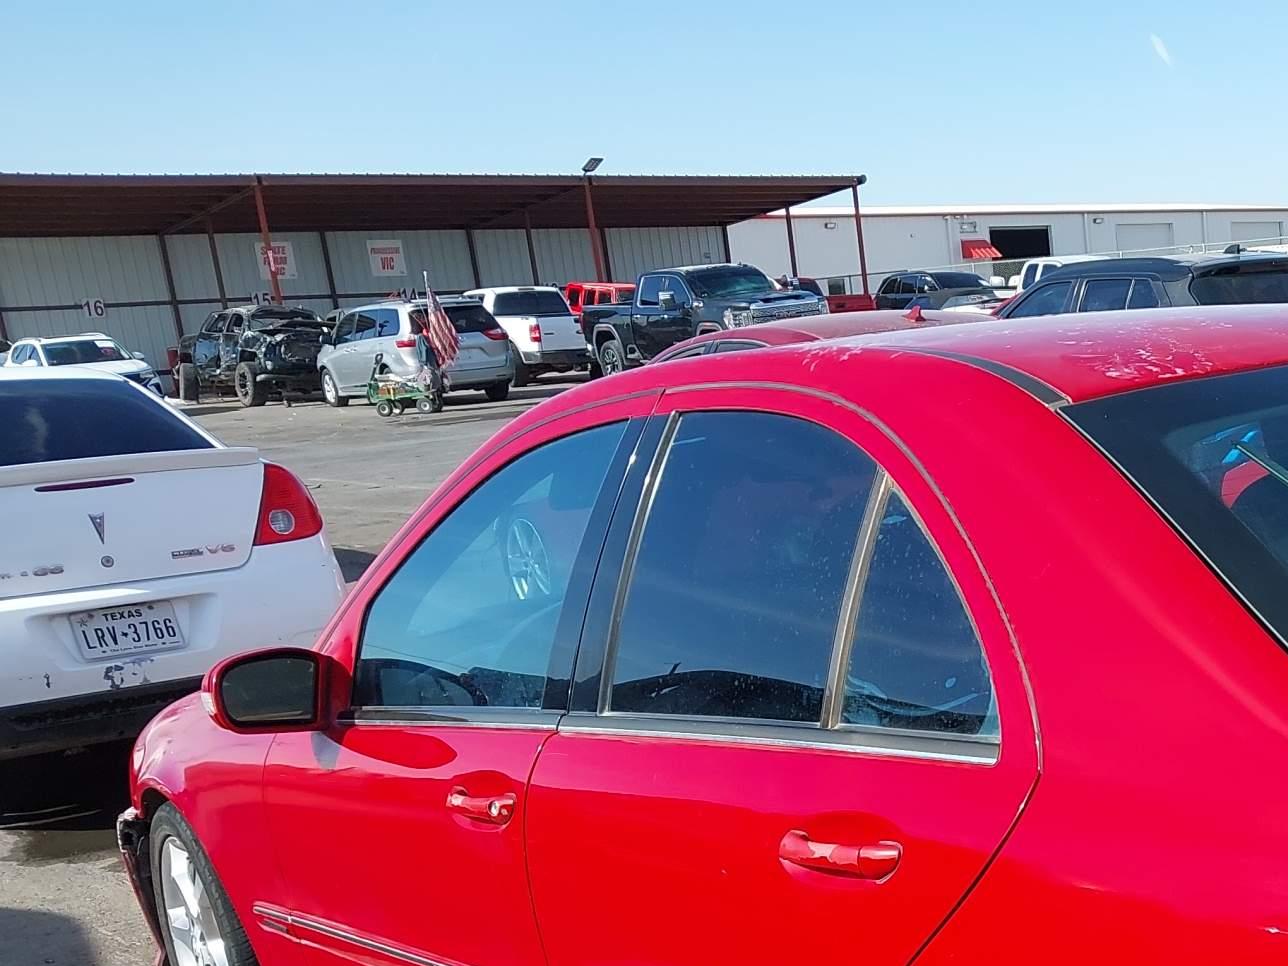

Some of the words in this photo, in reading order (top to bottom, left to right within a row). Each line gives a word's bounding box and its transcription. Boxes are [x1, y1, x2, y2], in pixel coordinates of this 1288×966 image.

[380, 256, 395, 270] VIC
[83, 300, 104, 317] 16
[101, 608, 143, 622] TEXAS
[81, 625, 119, 650] LRV
[127, 618, 177, 643] 3766
